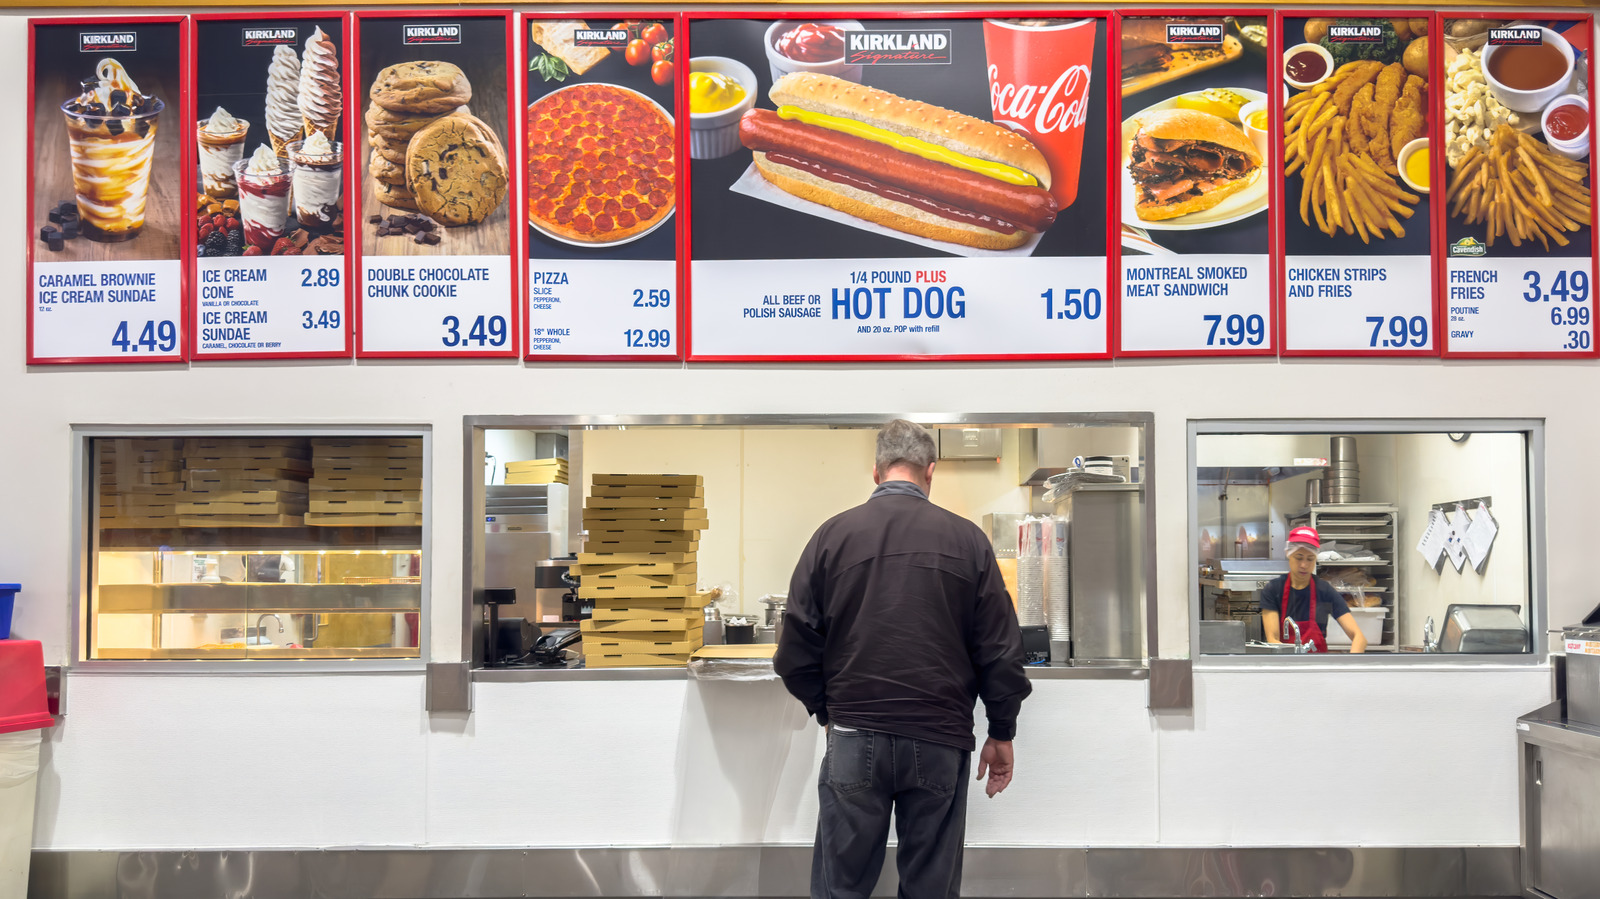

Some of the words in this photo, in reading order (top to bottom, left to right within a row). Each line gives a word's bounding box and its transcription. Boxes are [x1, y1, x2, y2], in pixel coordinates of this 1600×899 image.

[245, 30, 296, 39] KIRKLAND
[407, 27, 458, 36] KIRKLAND
[576, 31, 627, 40] KIRKLAND
[1170, 27, 1220, 36] KIRKLAND
[1330, 27, 1381, 36] KIRKLAND
[1490, 30, 1540, 39] KIRKLAND
[83, 35, 134, 44] KIRKLAND
[850, 34, 947, 50] KIRKLAND
[850, 50, 947, 65] Signature
[39, 274, 97, 287] CARAMEL
[101, 273, 156, 286] BROWNIE
[202, 270, 221, 283] ICE
[224, 269, 267, 282] CREAM
[301, 268, 340, 287] 2.89
[368, 268, 415, 281] DOUBLE
[419, 268, 489, 281] CHOCOLATE
[533, 272, 569, 284] PIZZA
[850, 271, 868, 284] 1/4
[871, 271, 912, 283] POUND
[915, 270, 947, 283] PLUS
[1126, 268, 1194, 280] MONTREAL
[1197, 267, 1248, 280] SMOKED
[1288, 268, 1340, 281] CHICKEN
[1344, 268, 1387, 281] STRIPS
[1450, 270, 1498, 283] FRENCH
[202, 286, 234, 299] CONE
[368, 285, 409, 297] CHUNK
[413, 285, 457, 297] COOKIE
[533, 287, 552, 295] SLICE
[1126, 284, 1160, 297] MEAT
[1163, 283, 1229, 296] SANDWICH
[1288, 285, 1314, 297] AND
[1318, 285, 1352, 297] FRIES
[1450, 287, 1485, 299] FRIES
[1523, 271, 1589, 302] 3.49
[39, 291, 58, 304] ICE
[61, 290, 104, 303] CREAM
[108, 289, 156, 302] SUNDAE
[633, 289, 670, 308] 2.59
[762, 295, 780, 305] ALL
[783, 295, 805, 304] BEEF
[808, 294, 821, 304] OR
[831, 287, 892, 320] HOT
[903, 286, 966, 319] DOG
[1041, 288, 1101, 320] 1.50
[202, 312, 221, 324] ICE
[225, 311, 268, 324] CREAM
[302, 310, 340, 329] 3.49
[743, 308, 776, 318] POLISH
[778, 308, 821, 318] SAUSAGE
[1551, 307, 1590, 325] 6.99
[202, 328, 251, 341] SUNDAE
[442, 315, 507, 347] 3.49
[547, 328, 570, 336] WHOLE
[894, 325, 907, 333] POP
[908, 325, 923, 333] with
[925, 325, 940, 333] refill
[1203, 314, 1264, 346] 7.99
[1365, 316, 1428, 347] 7.99
[112, 320, 176, 352] 4.49
[624, 329, 670, 347] 12.99
[1563, 330, 1590, 349] .30
